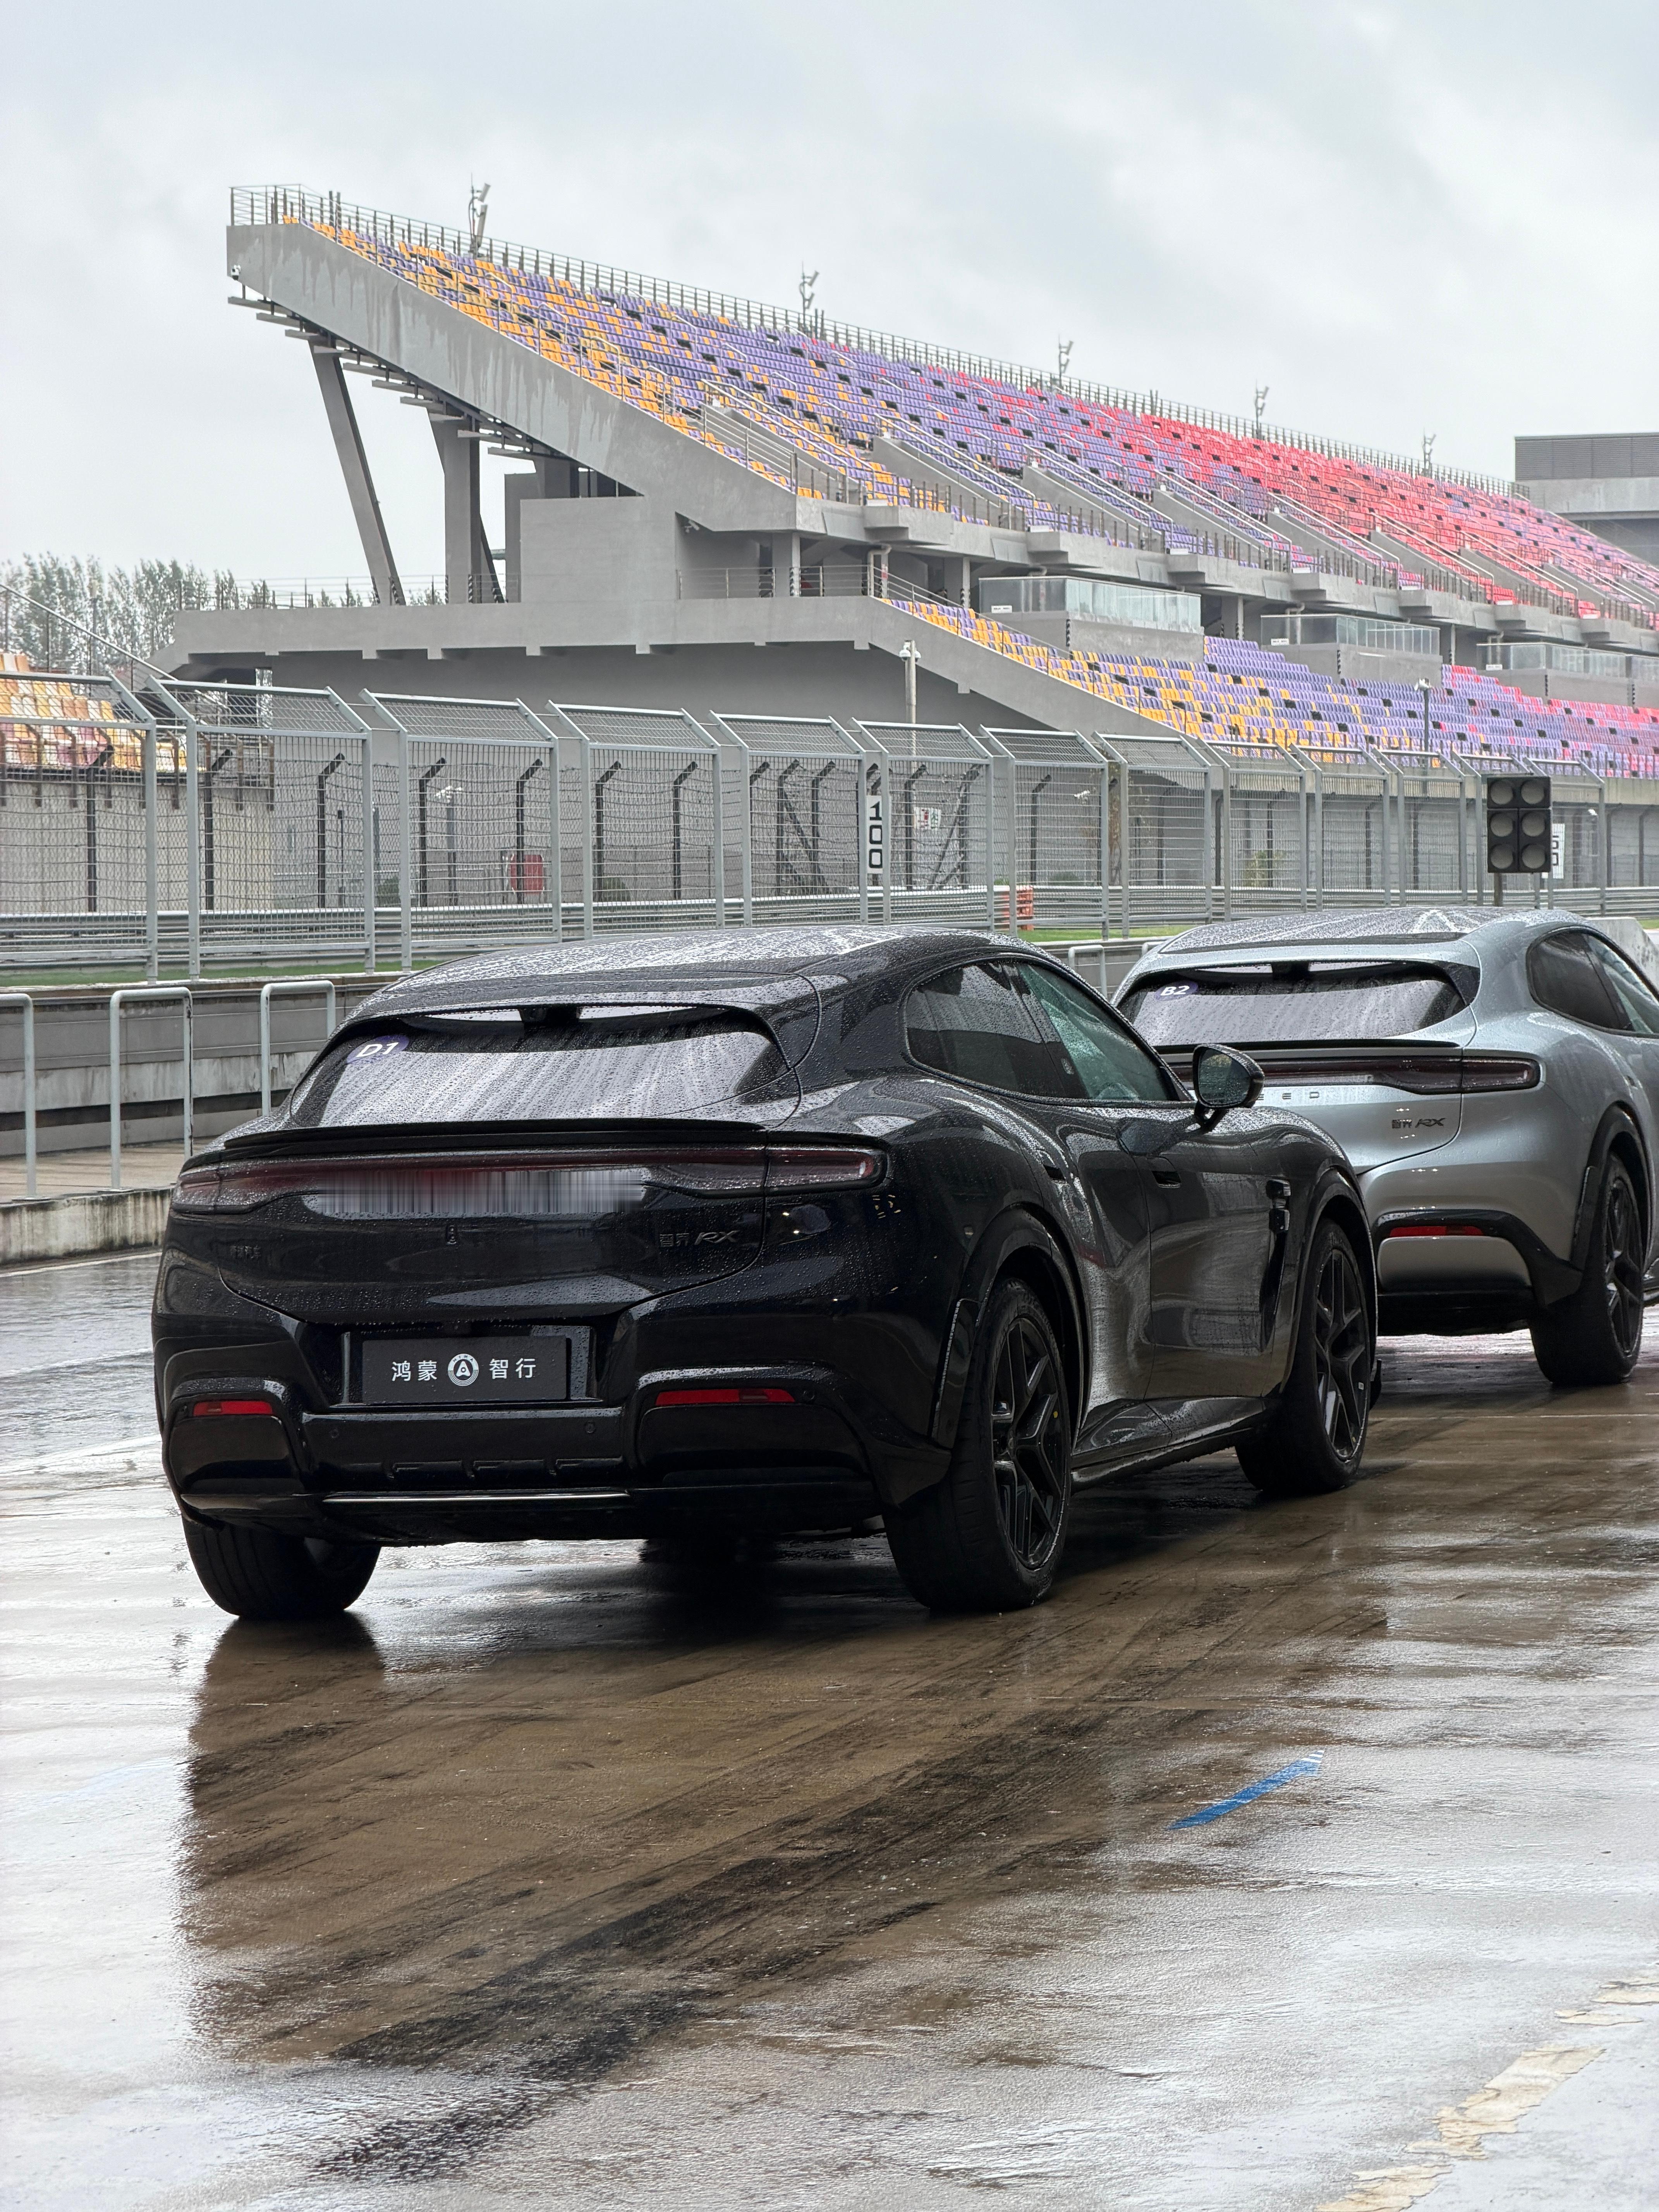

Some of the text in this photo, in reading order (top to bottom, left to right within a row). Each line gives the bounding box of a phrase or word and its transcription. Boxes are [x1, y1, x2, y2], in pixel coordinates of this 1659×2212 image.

[869, 801, 883, 868] 100
[1160, 985, 1190, 996] B2
[356, 1042, 398, 1058] D1
[1415, 1118, 1446, 1128] RX
[694, 1230, 740, 1245] RX
[392, 1358, 536, 1382] 鸿蒙 智行
